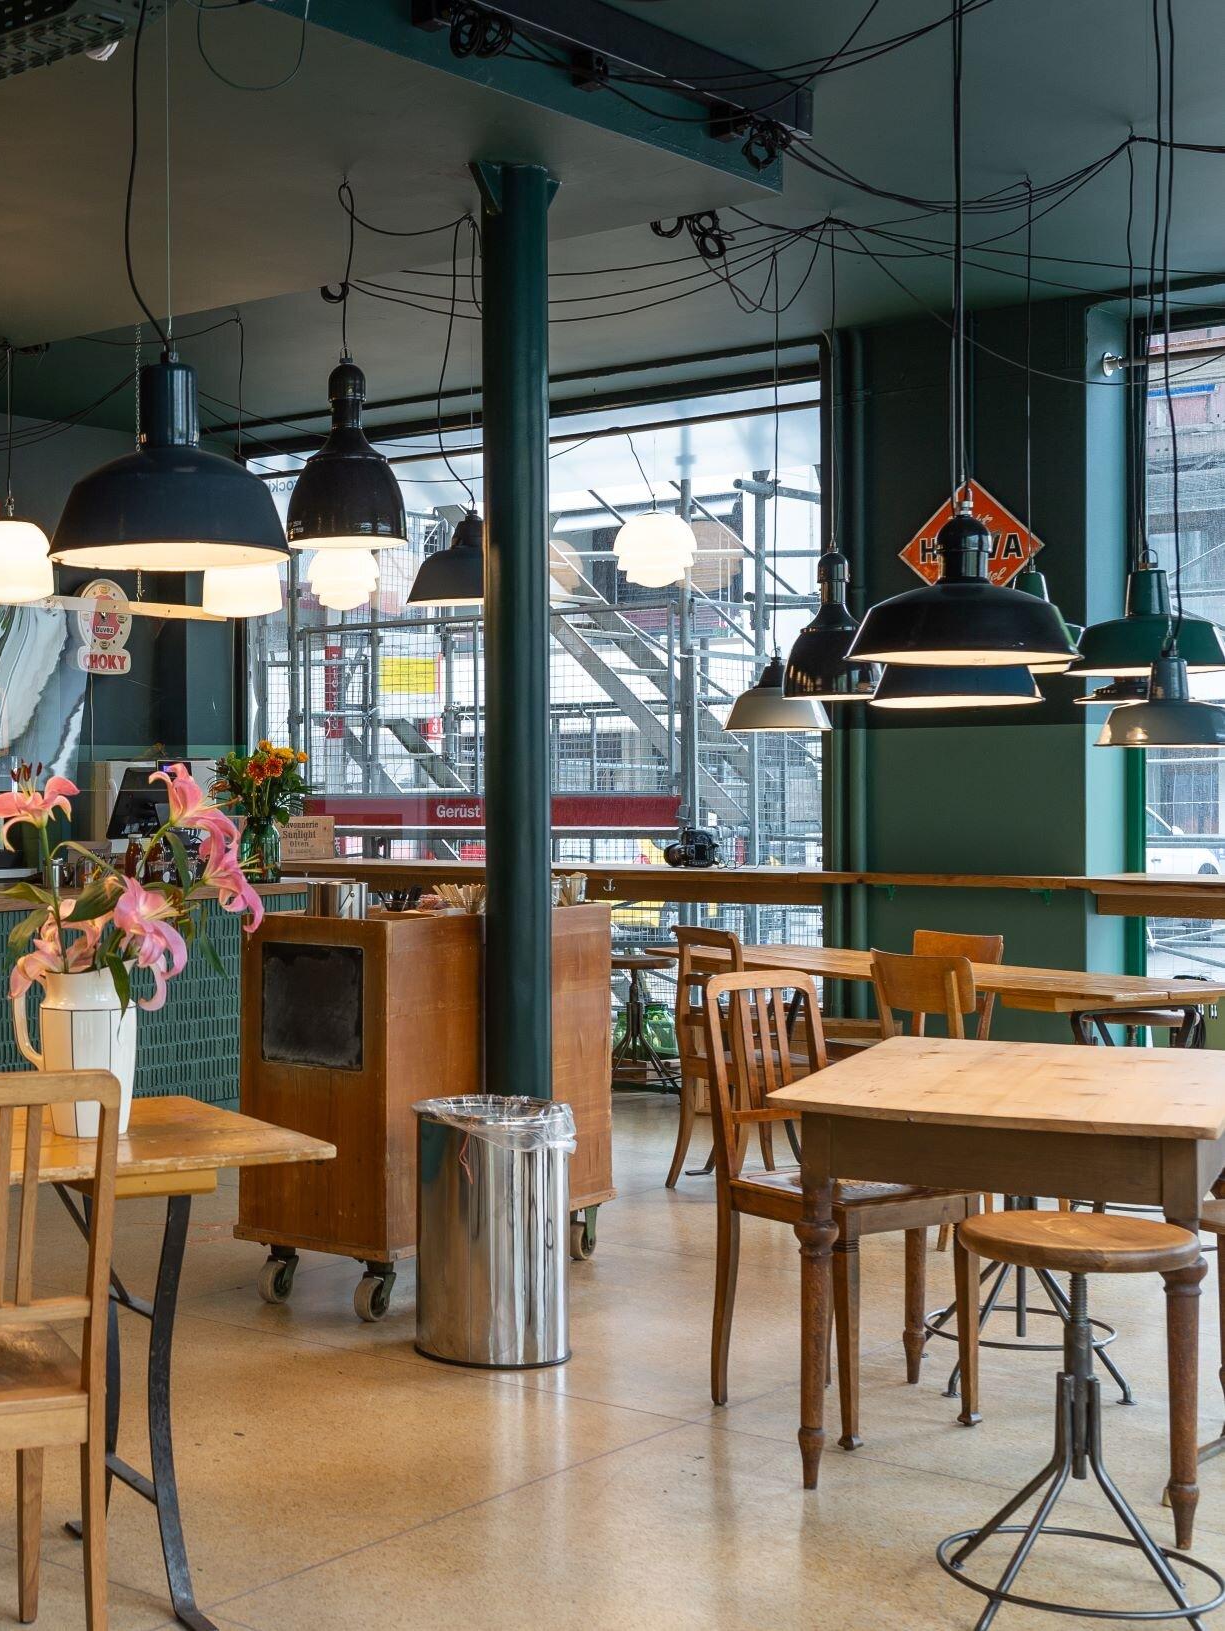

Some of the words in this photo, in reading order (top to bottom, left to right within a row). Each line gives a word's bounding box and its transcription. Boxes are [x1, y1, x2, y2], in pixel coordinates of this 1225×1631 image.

[83, 653, 127, 670] CHOKY
[436, 804, 481, 818] Gerüst
[282, 830, 317, 841] Sunlight
